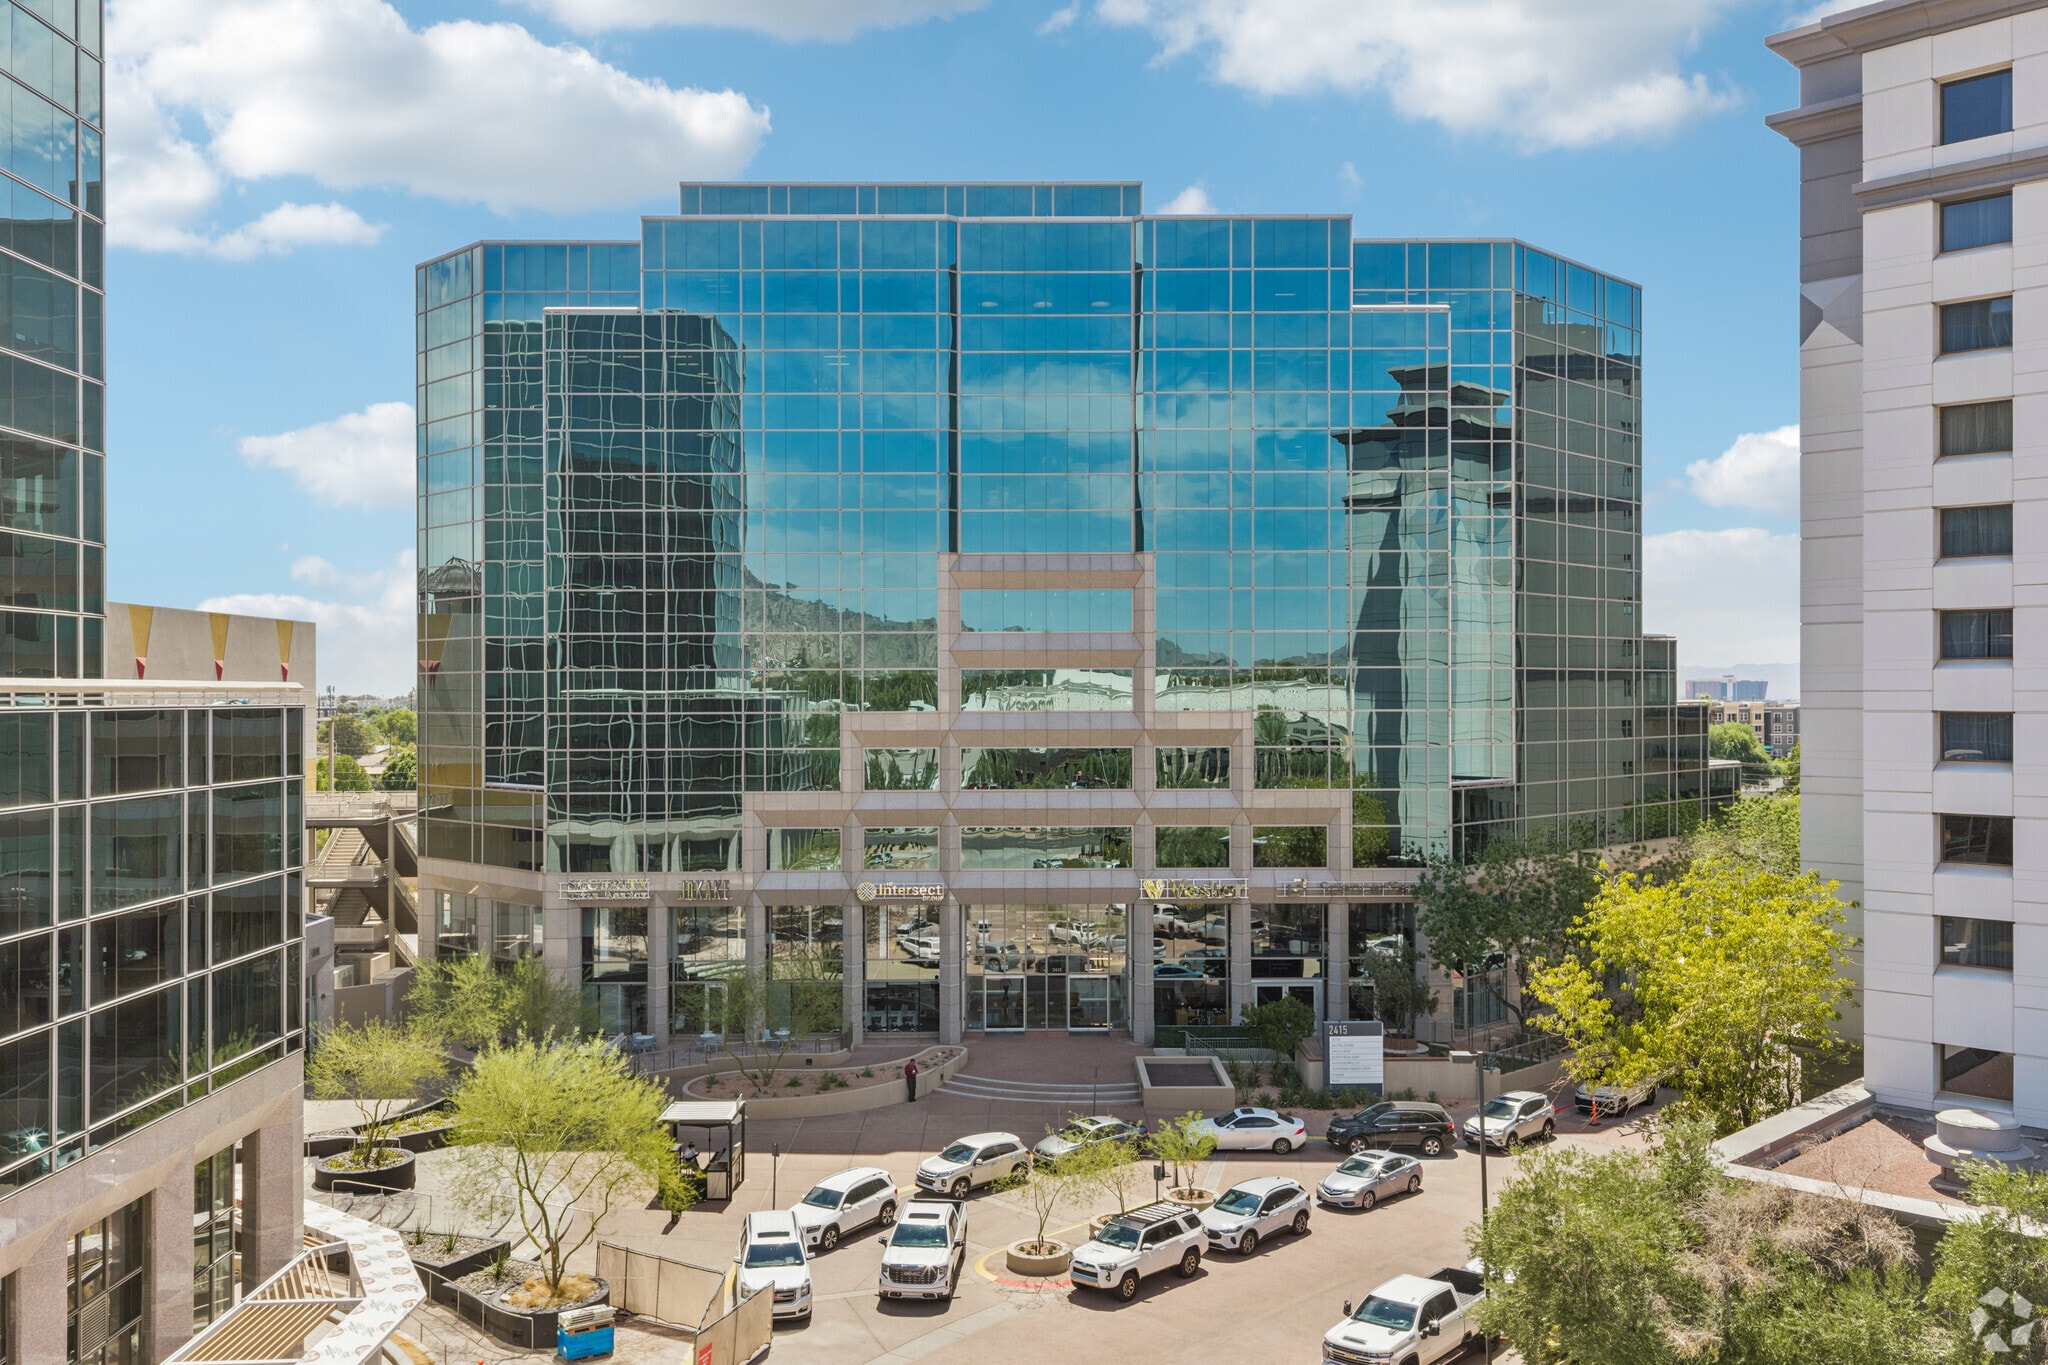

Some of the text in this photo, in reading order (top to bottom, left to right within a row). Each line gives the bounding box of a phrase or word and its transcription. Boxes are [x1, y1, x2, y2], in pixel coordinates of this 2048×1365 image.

[678, 880, 730, 900] JOKAKE
[879, 884, 942, 896] Intersect
[1328, 1025, 1348, 1035] 2415
